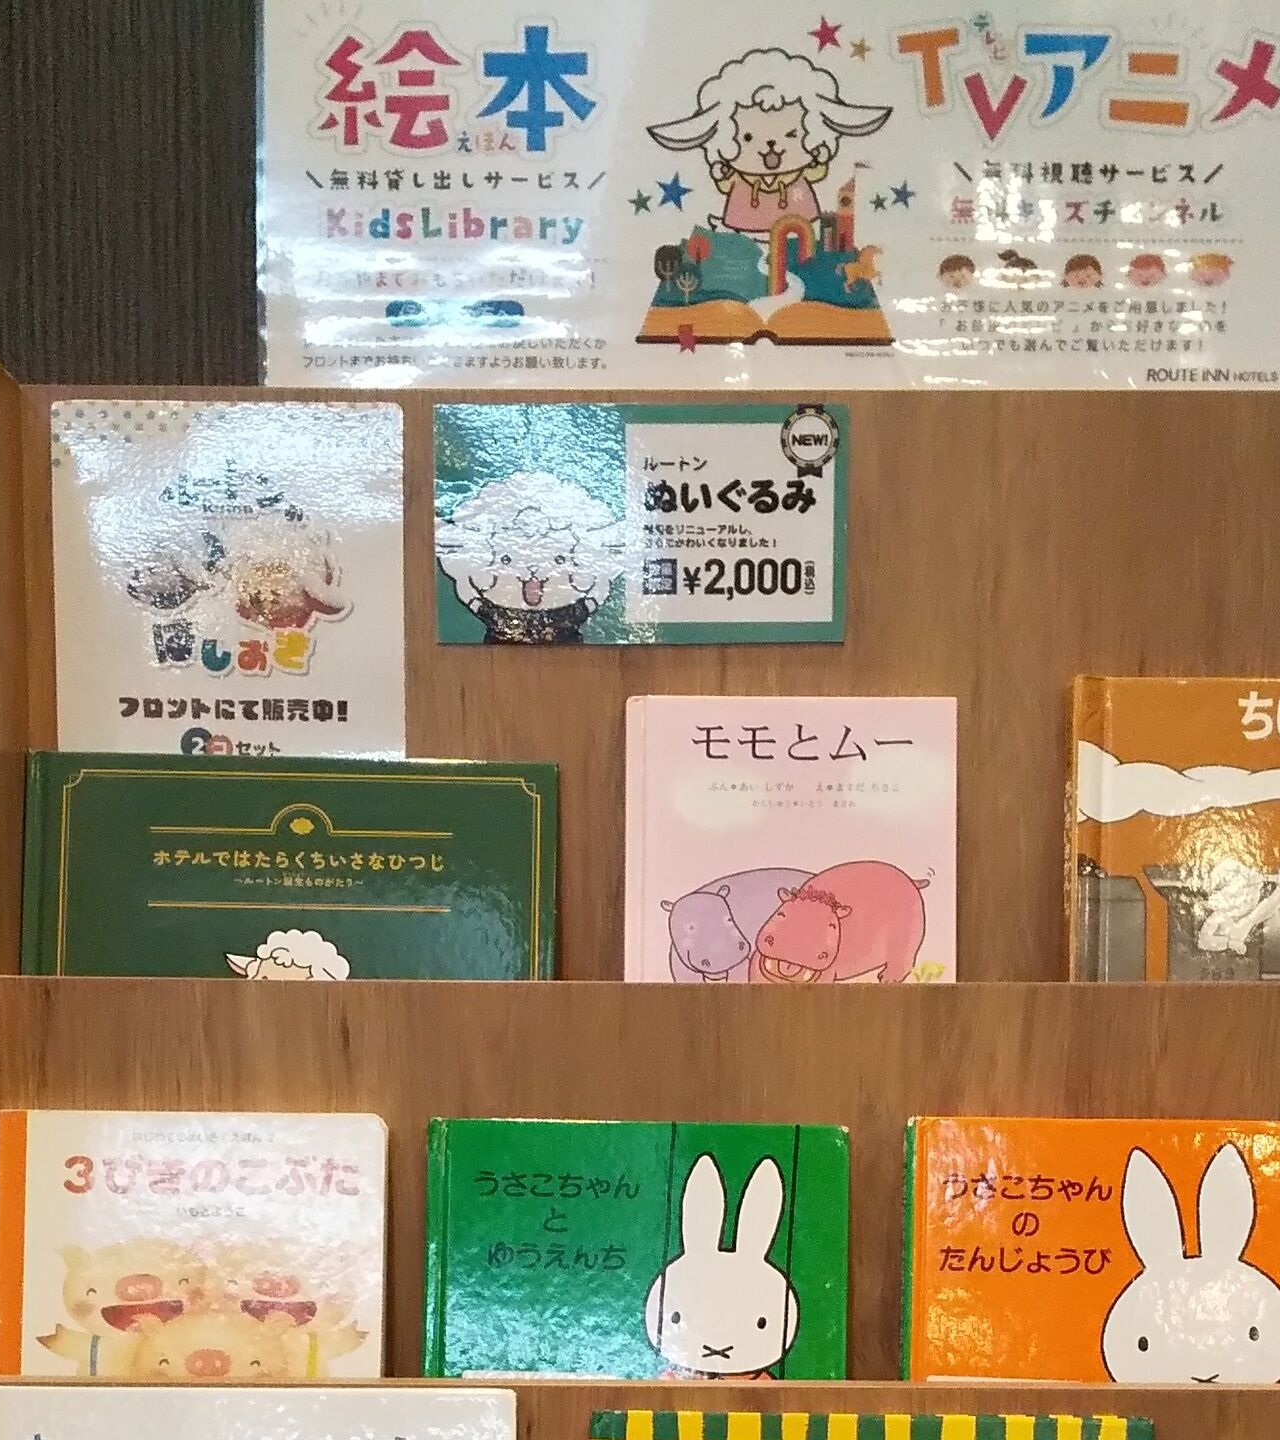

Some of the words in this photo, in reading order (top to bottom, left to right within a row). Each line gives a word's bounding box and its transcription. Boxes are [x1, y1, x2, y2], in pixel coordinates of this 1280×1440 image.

[318, 26, 597, 152] 絵本
[457, 131, 516, 154] えほん
[329, 169, 581, 191] 無料貸し出しサービス
[1146, 368, 1199, 384] ROUTE
[1201, 368, 1230, 384] INN
[1232, 371, 1279, 383] HOTELS
[791, 431, 831, 448] NEW!
[642, 455, 709, 473] ルートン
[642, 477, 818, 514] ぬいぐるみ
[682, 558, 802, 601] ¥2,000
[691, 722, 914, 761] モモとムー
[152, 848, 445, 872] ホテルではたらくちいさなひつじ
[63, 1153, 361, 1197] 3びきのこぶた
[474, 1170, 640, 1201] うさこちゃん
[942, 1173, 1114, 1202] うさこちゃん
[541, 1207, 569, 1234] と
[1011, 1211, 1041, 1237] の
[486, 1243, 628, 1271] ゆうえんち
[938, 1245, 1112, 1276] たんじょうび
